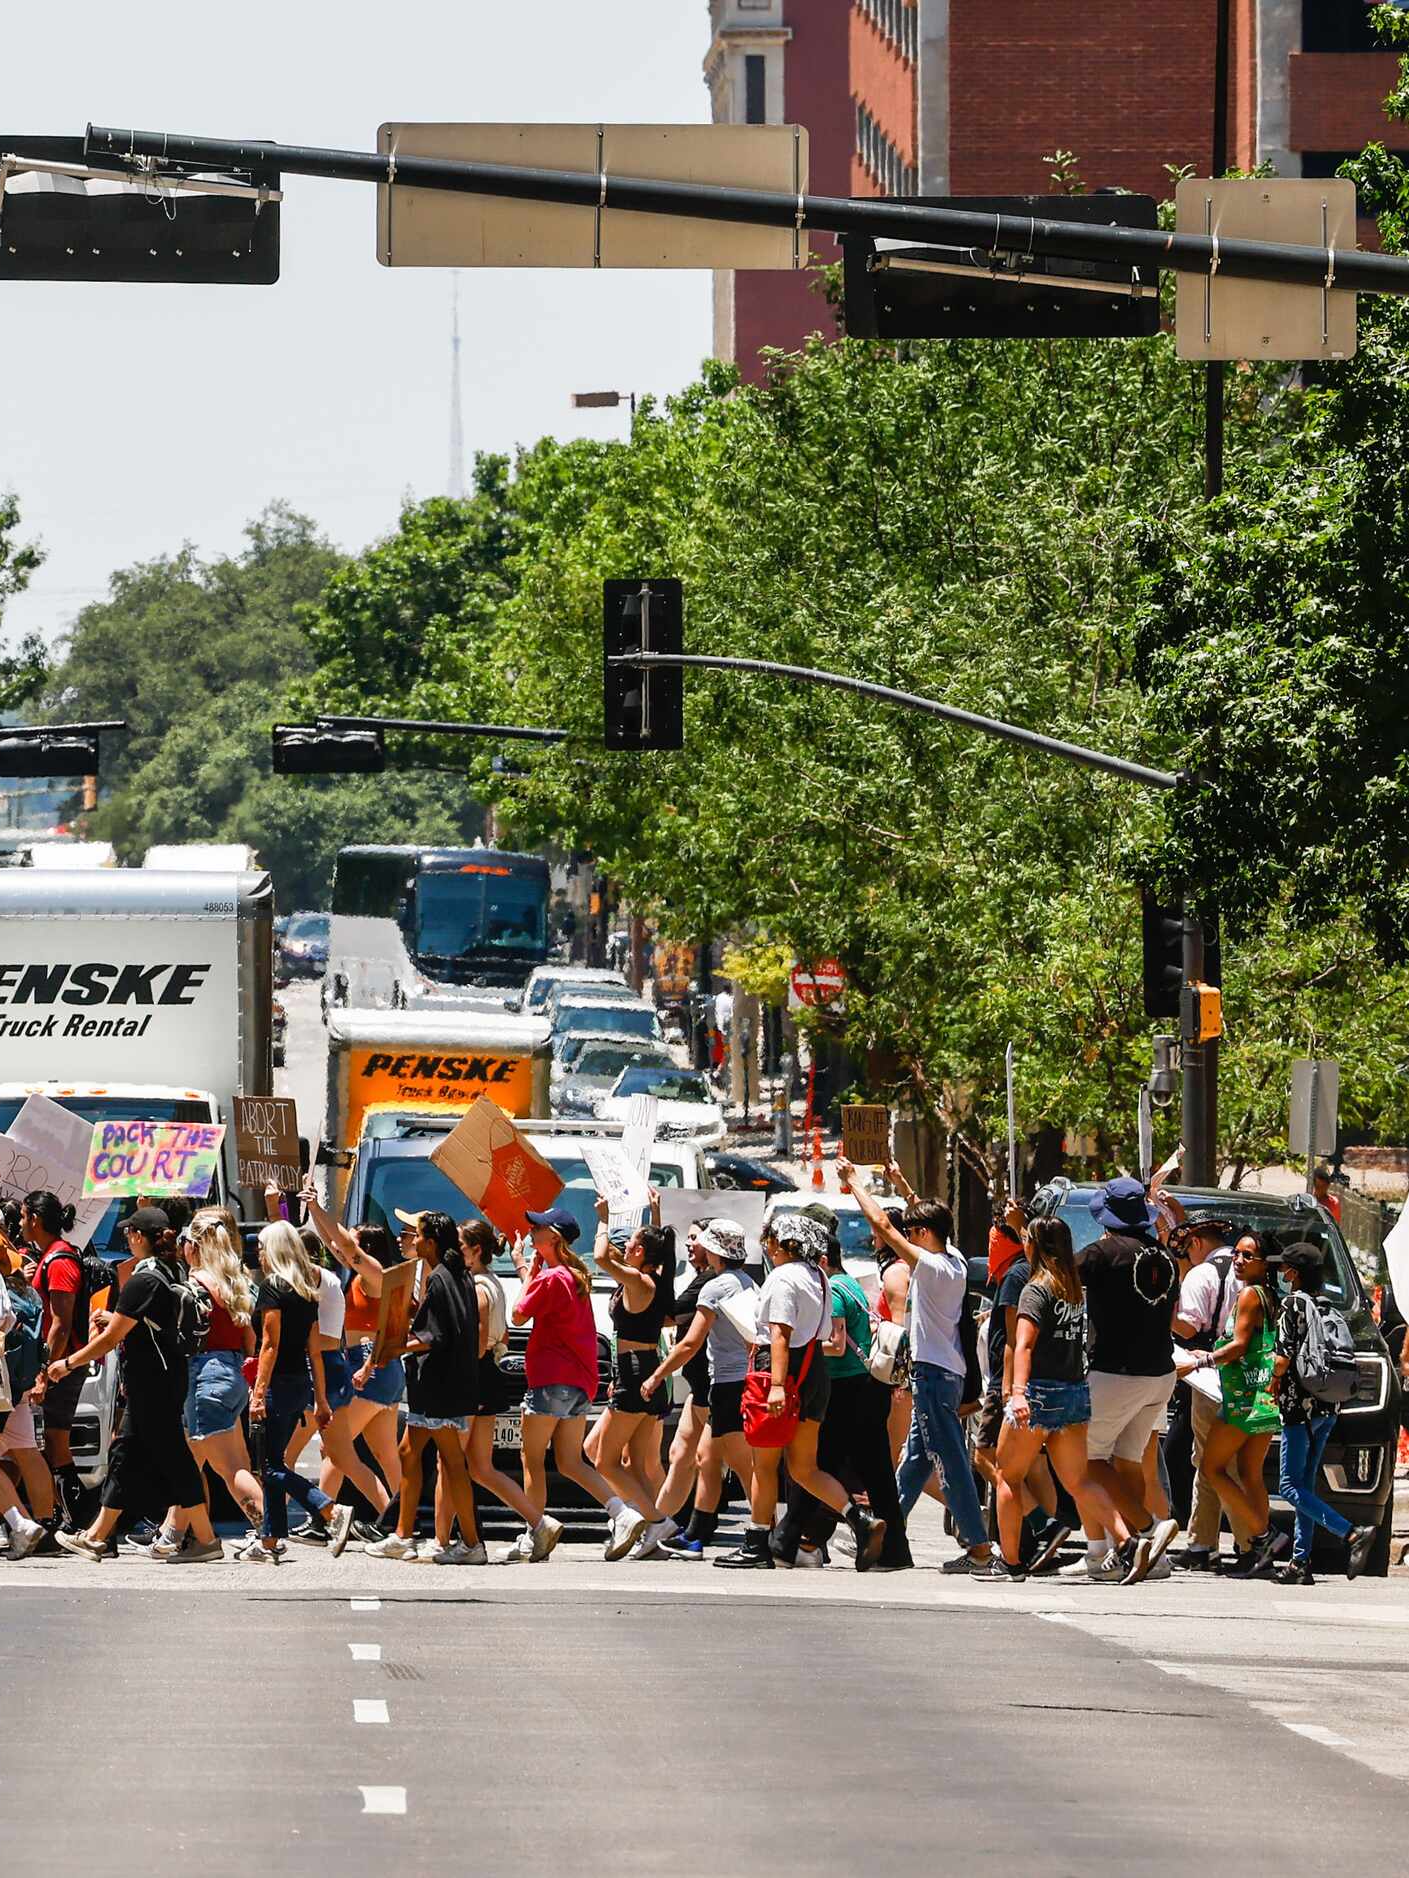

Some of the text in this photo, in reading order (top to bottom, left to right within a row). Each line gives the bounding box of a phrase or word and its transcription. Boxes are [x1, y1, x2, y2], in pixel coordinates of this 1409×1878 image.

[203, 902, 235, 914] 488053
[62, 1013, 153, 1038] Rental
[361, 1053, 520, 1083] PENSKE
[241, 1102, 289, 1136] ABORT
[103, 1122, 217, 1149] PACK THE
[253, 1136, 279, 1155] THE
[94, 1150, 198, 1180] COURT
[239, 1158, 303, 1191] PATRIARCHY
